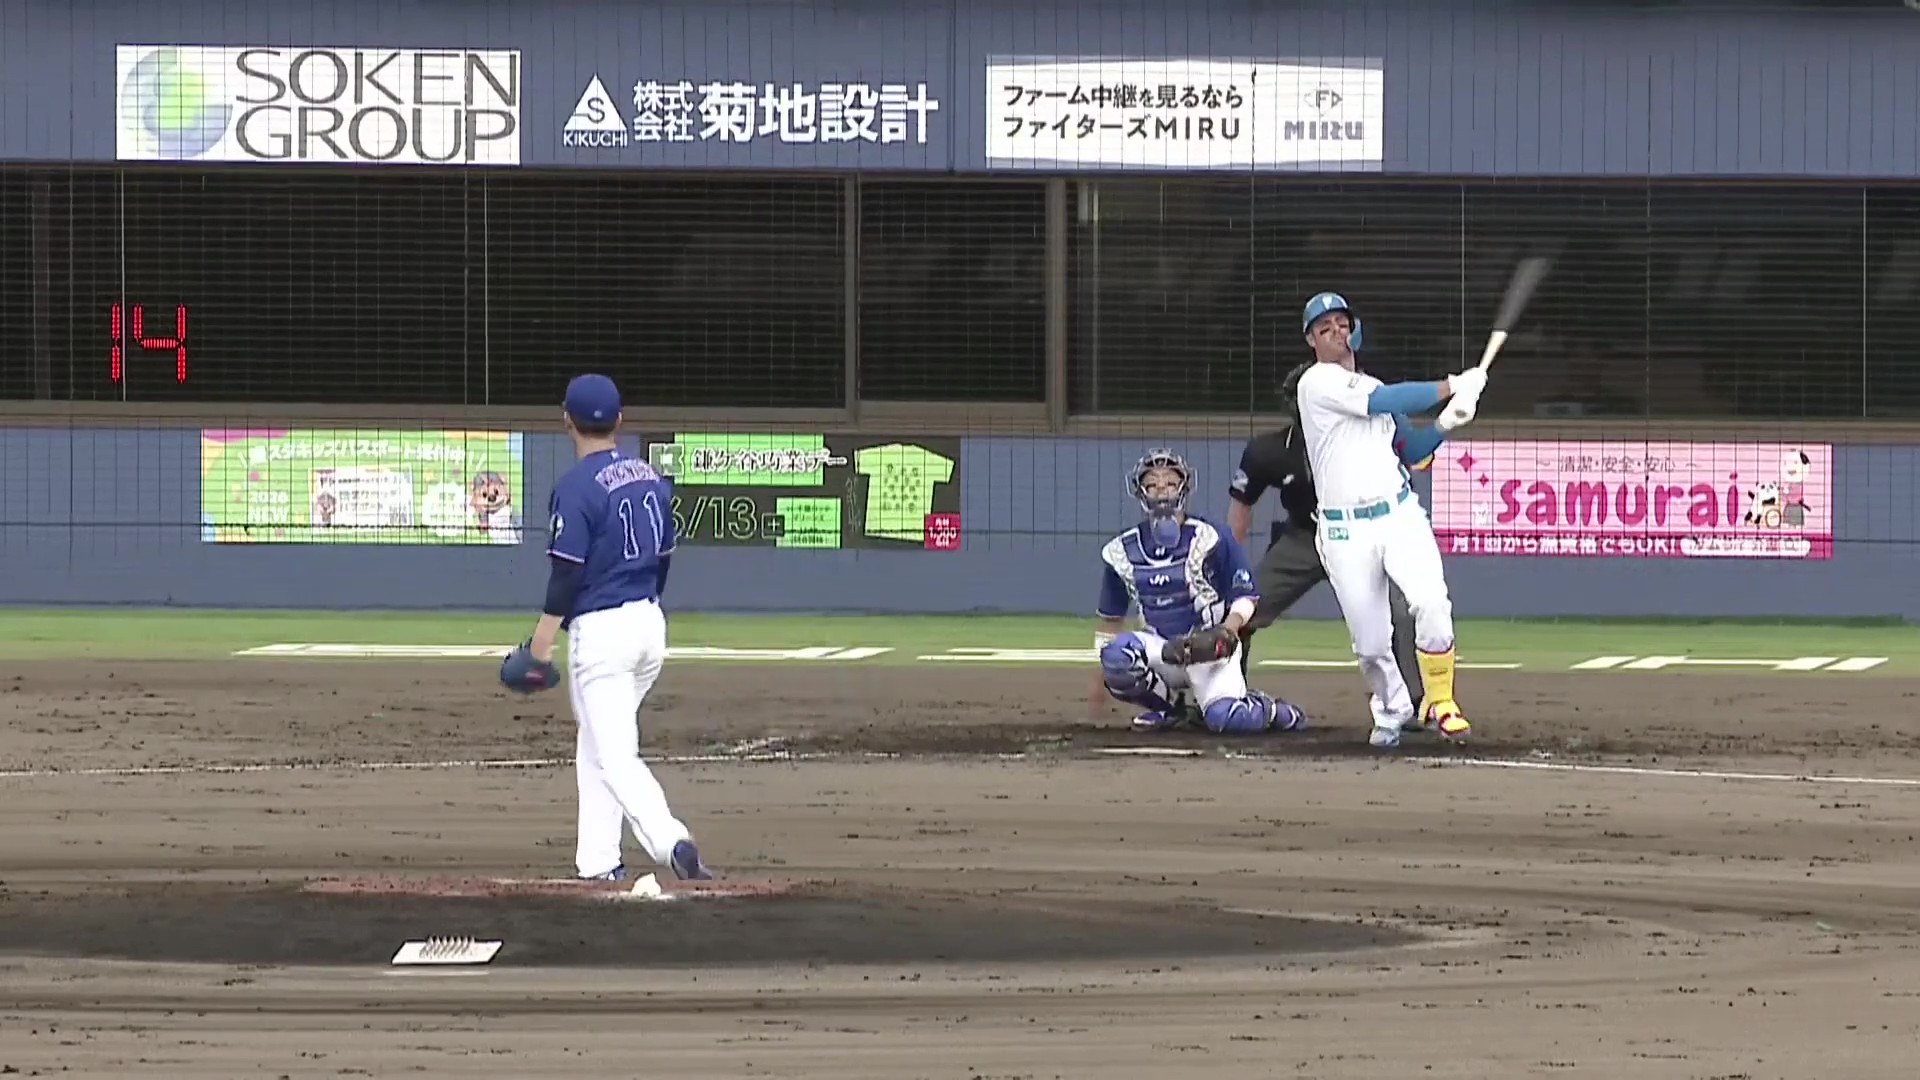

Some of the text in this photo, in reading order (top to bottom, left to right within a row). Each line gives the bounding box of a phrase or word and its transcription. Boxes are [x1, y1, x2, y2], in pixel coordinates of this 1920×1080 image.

[235, 48, 517, 106] SOKEN
[633, 80, 694, 111] 株式
[1003, 84, 1243, 109] ファーム中継を見るなら
[632, 112, 694, 142] 会社
[697, 80, 940, 144] 菊地設計
[1003, 113, 1240, 140] ファイターズMIRU
[235, 104, 517, 161] GROUP
[562, 130, 628, 147] KIKUCHI
[1283, 120, 1364, 141] MIRU
[111, 303, 187, 384] 14
[247, 506, 290, 524] NEW
[1496, 471, 1740, 528] samurai
[618, 490, 665, 561] 11
